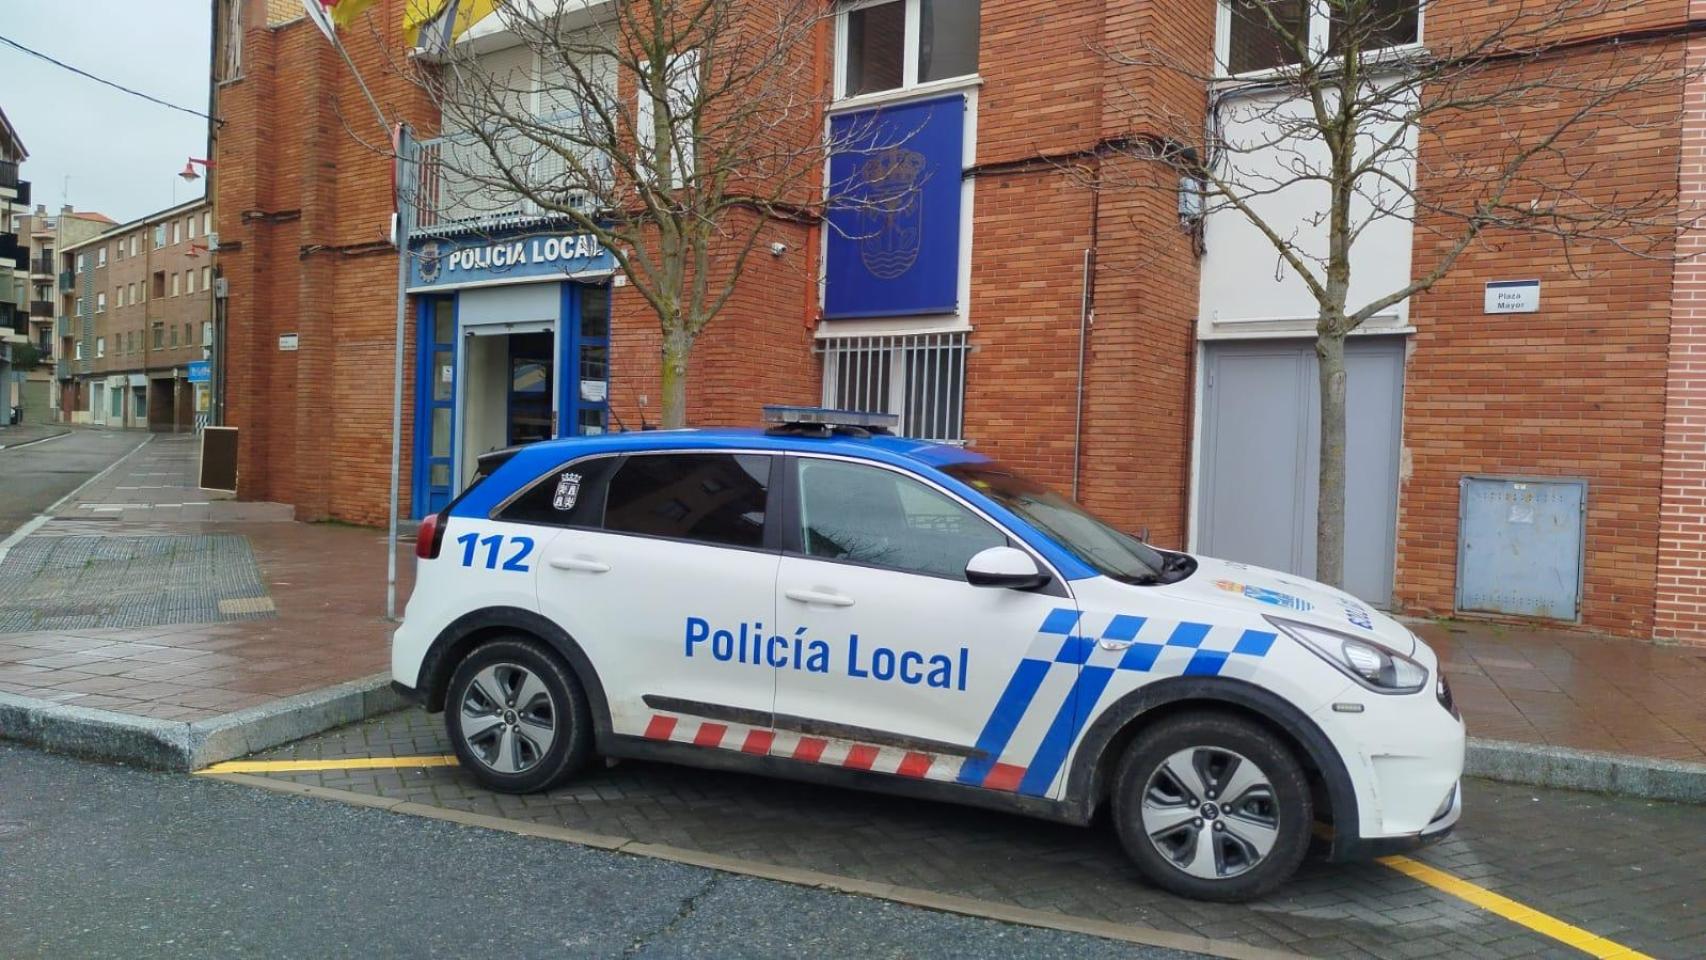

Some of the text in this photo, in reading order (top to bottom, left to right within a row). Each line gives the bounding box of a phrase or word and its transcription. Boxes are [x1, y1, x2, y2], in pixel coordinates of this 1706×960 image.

[532, 234, 604, 263] LOCAL
[1497, 302, 1525, 310] Mayor
[1498, 292, 1521, 300] Plaza
[457, 532, 535, 573] 112
[685, 616, 969, 692] Policía Local
